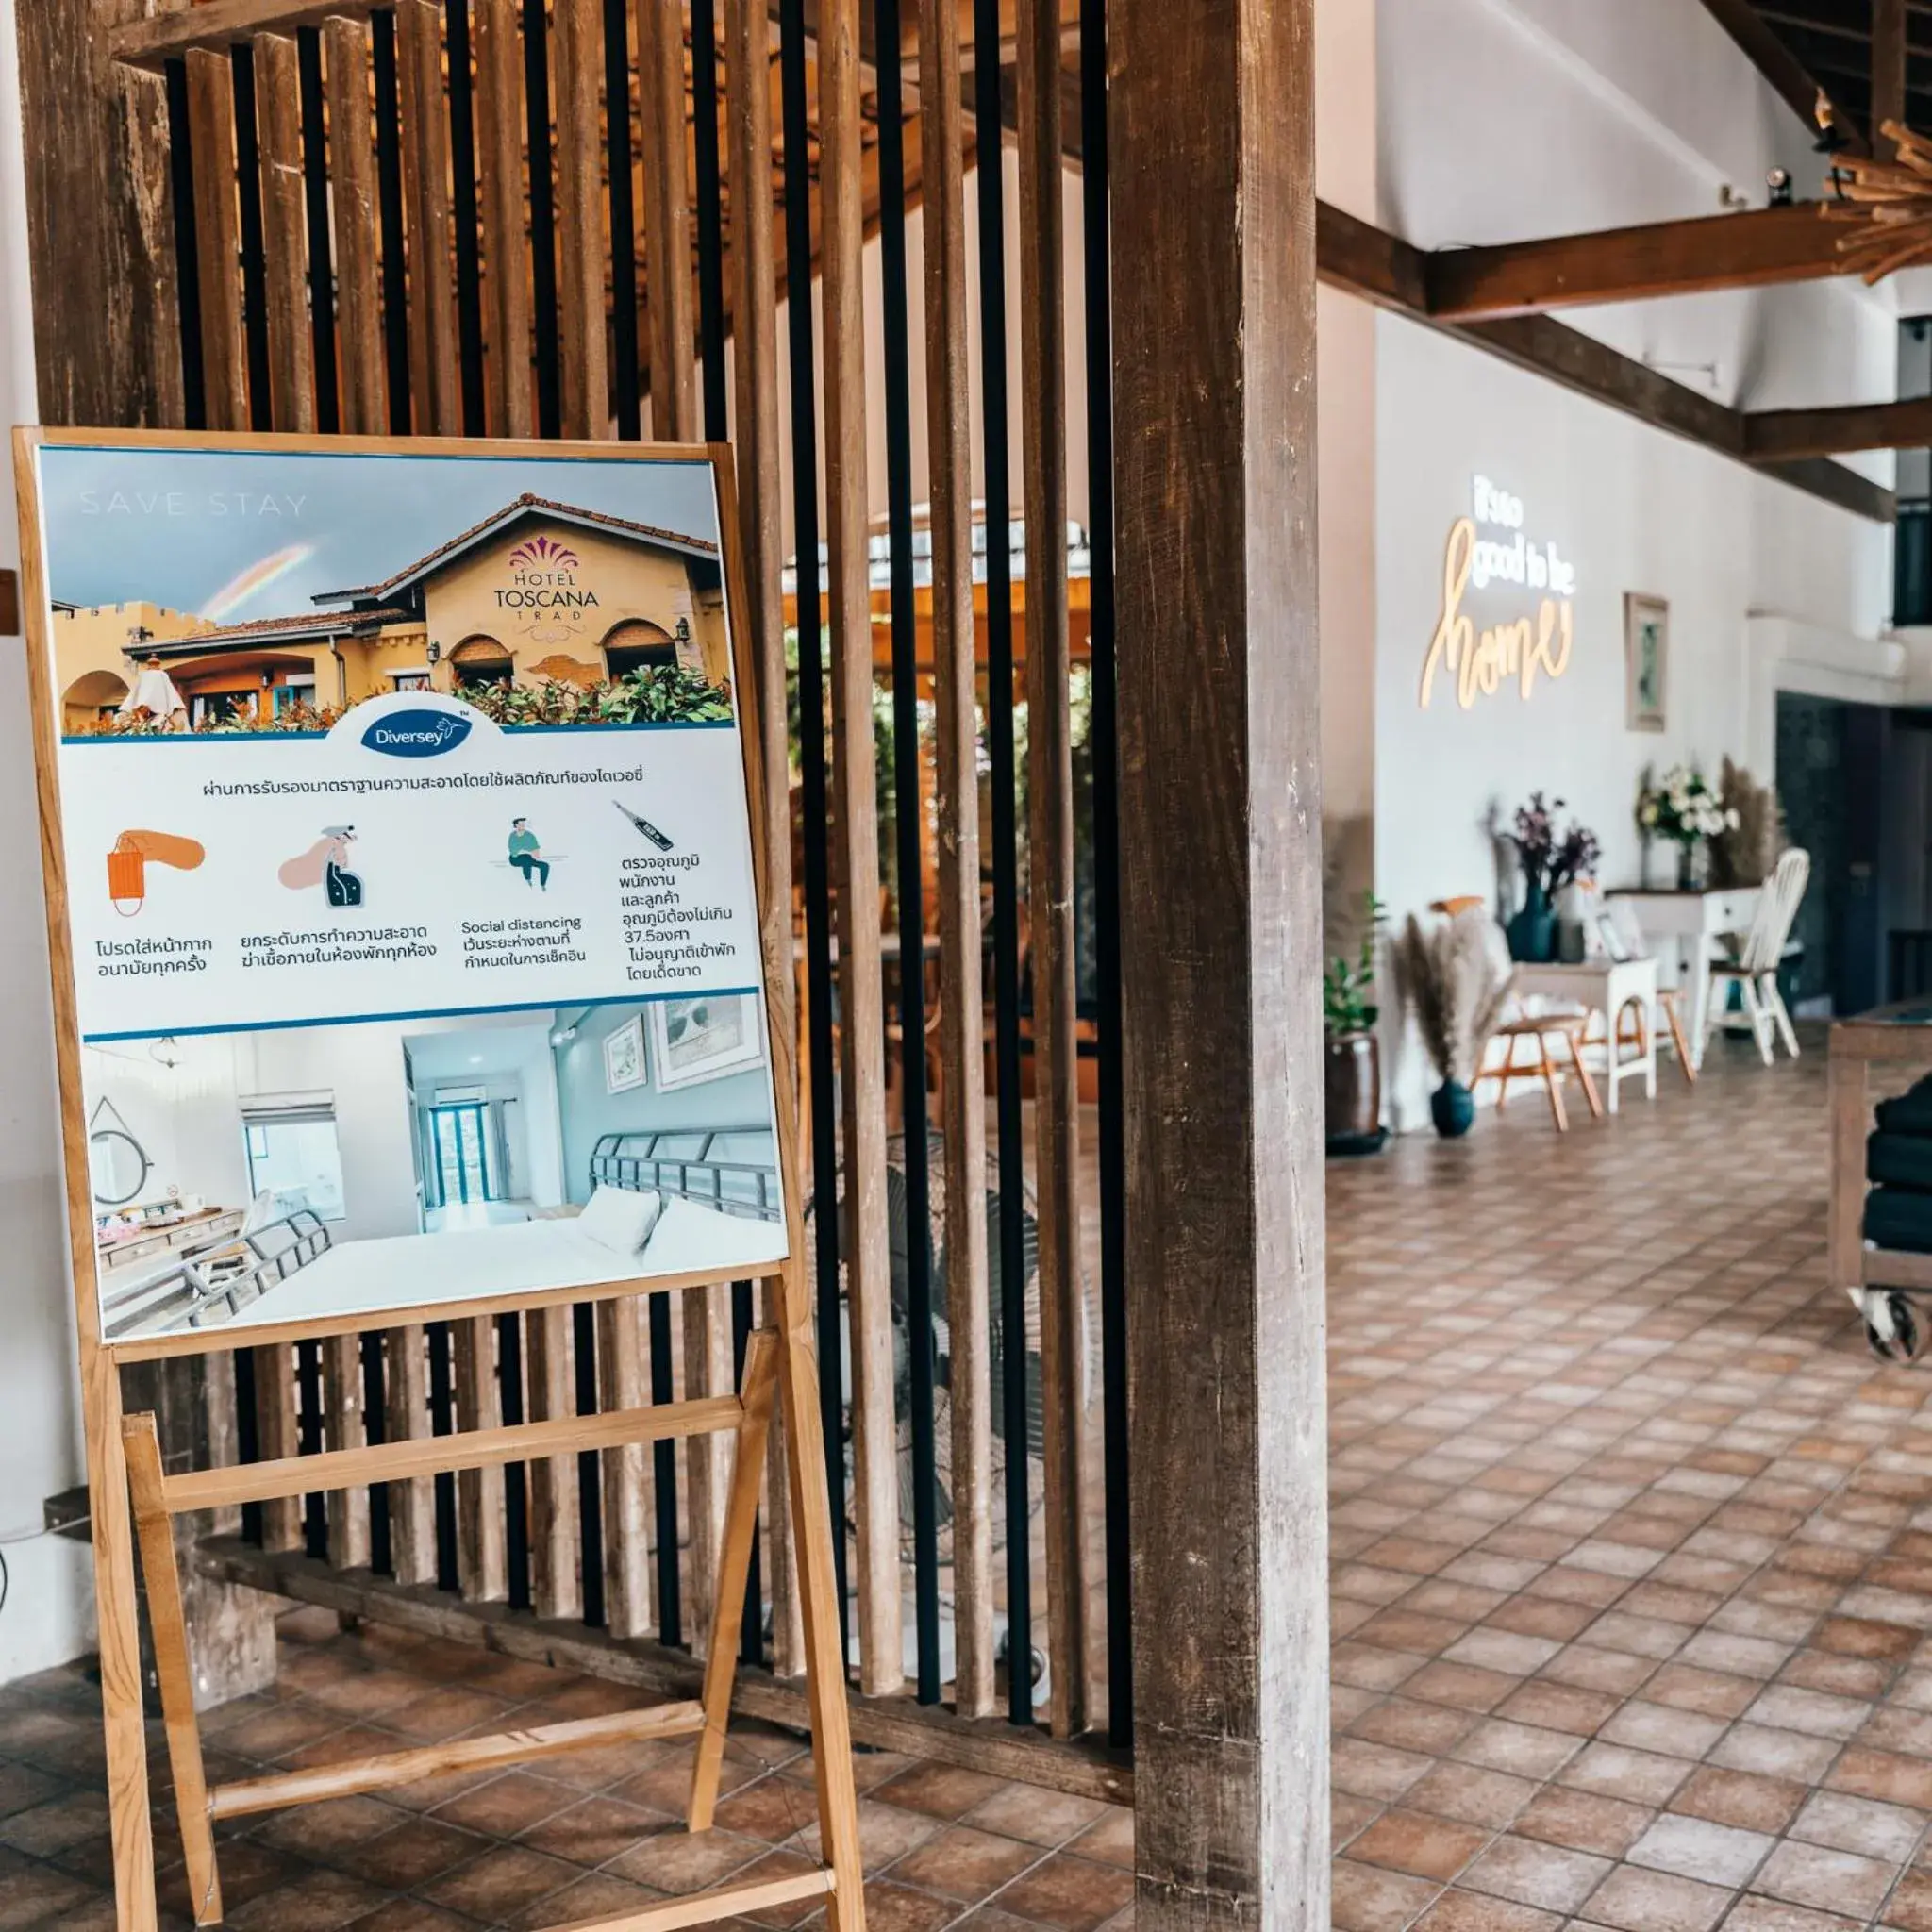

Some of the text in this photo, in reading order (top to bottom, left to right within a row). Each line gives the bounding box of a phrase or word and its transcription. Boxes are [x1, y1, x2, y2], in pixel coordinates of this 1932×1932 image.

[79, 490, 308, 518] SAVE STAY
[514, 573, 576, 587] HOTEL
[493, 590, 600, 608] TOSCANA
[516, 610, 582, 621] TRAD
[1419, 516, 1574, 709] home
[375, 729, 443, 747] Diversey
[619, 874, 675, 889] พนักงาน
[621, 890, 680, 909] และลูกค้า
[461, 916, 582, 935] Social distancing
[241, 924, 428, 948] ยกระดับการทำความสะอาด
[624, 929, 691, 944] 37.5องศา
[95, 937, 213, 957] โปรดใส่หน้ากาก
[97, 954, 208, 977] อนามัยทุกครั้ง
[625, 963, 702, 981] โดยเด็ดขาด
